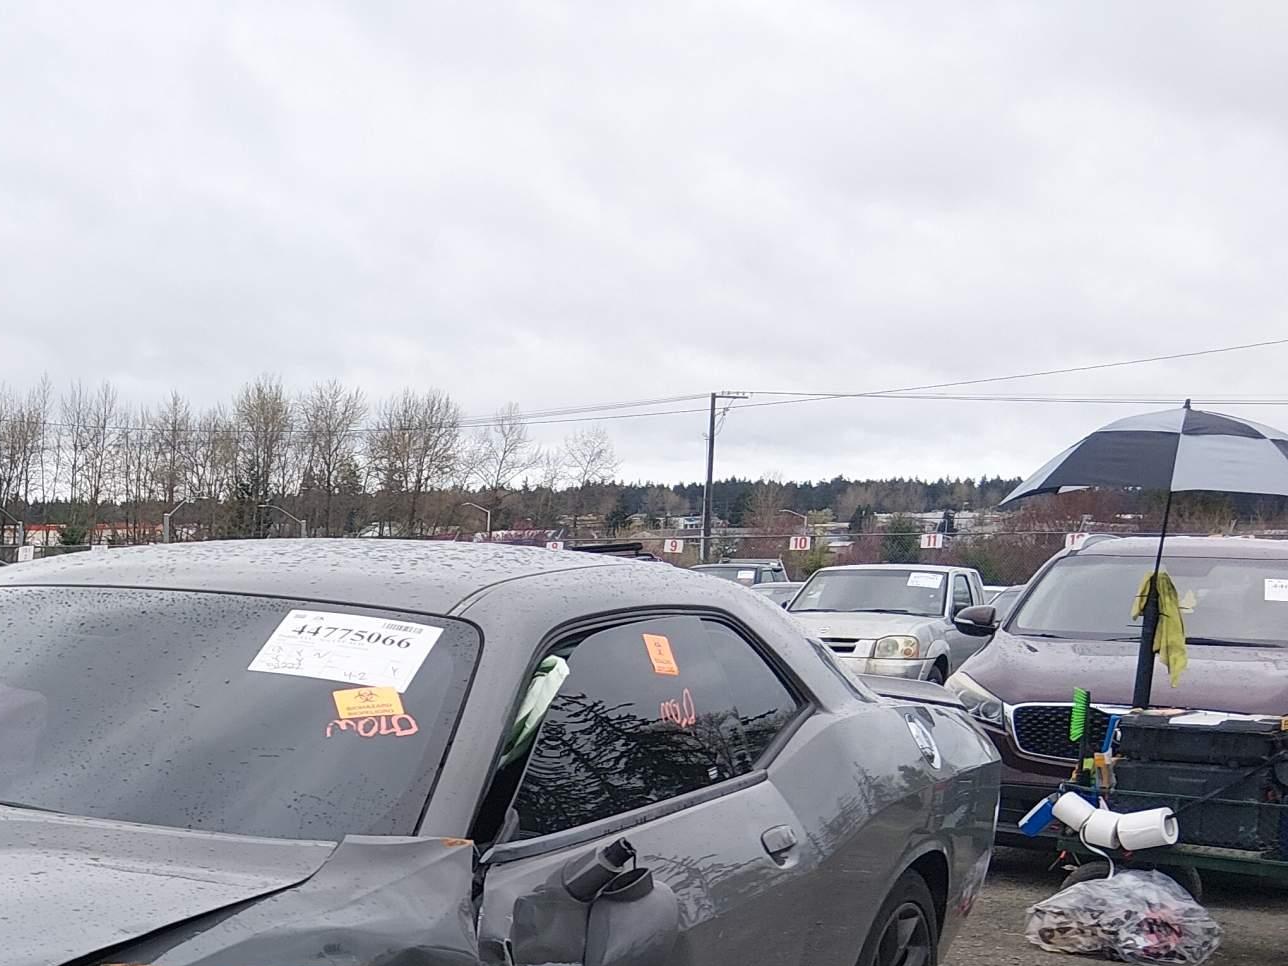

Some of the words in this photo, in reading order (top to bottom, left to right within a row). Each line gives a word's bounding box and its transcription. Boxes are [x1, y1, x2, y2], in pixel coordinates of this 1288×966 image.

[670, 540, 678, 552] 9
[794, 537, 807, 549] 10
[926, 535, 938, 547] 11
[291, 623, 416, 649] 44775066
